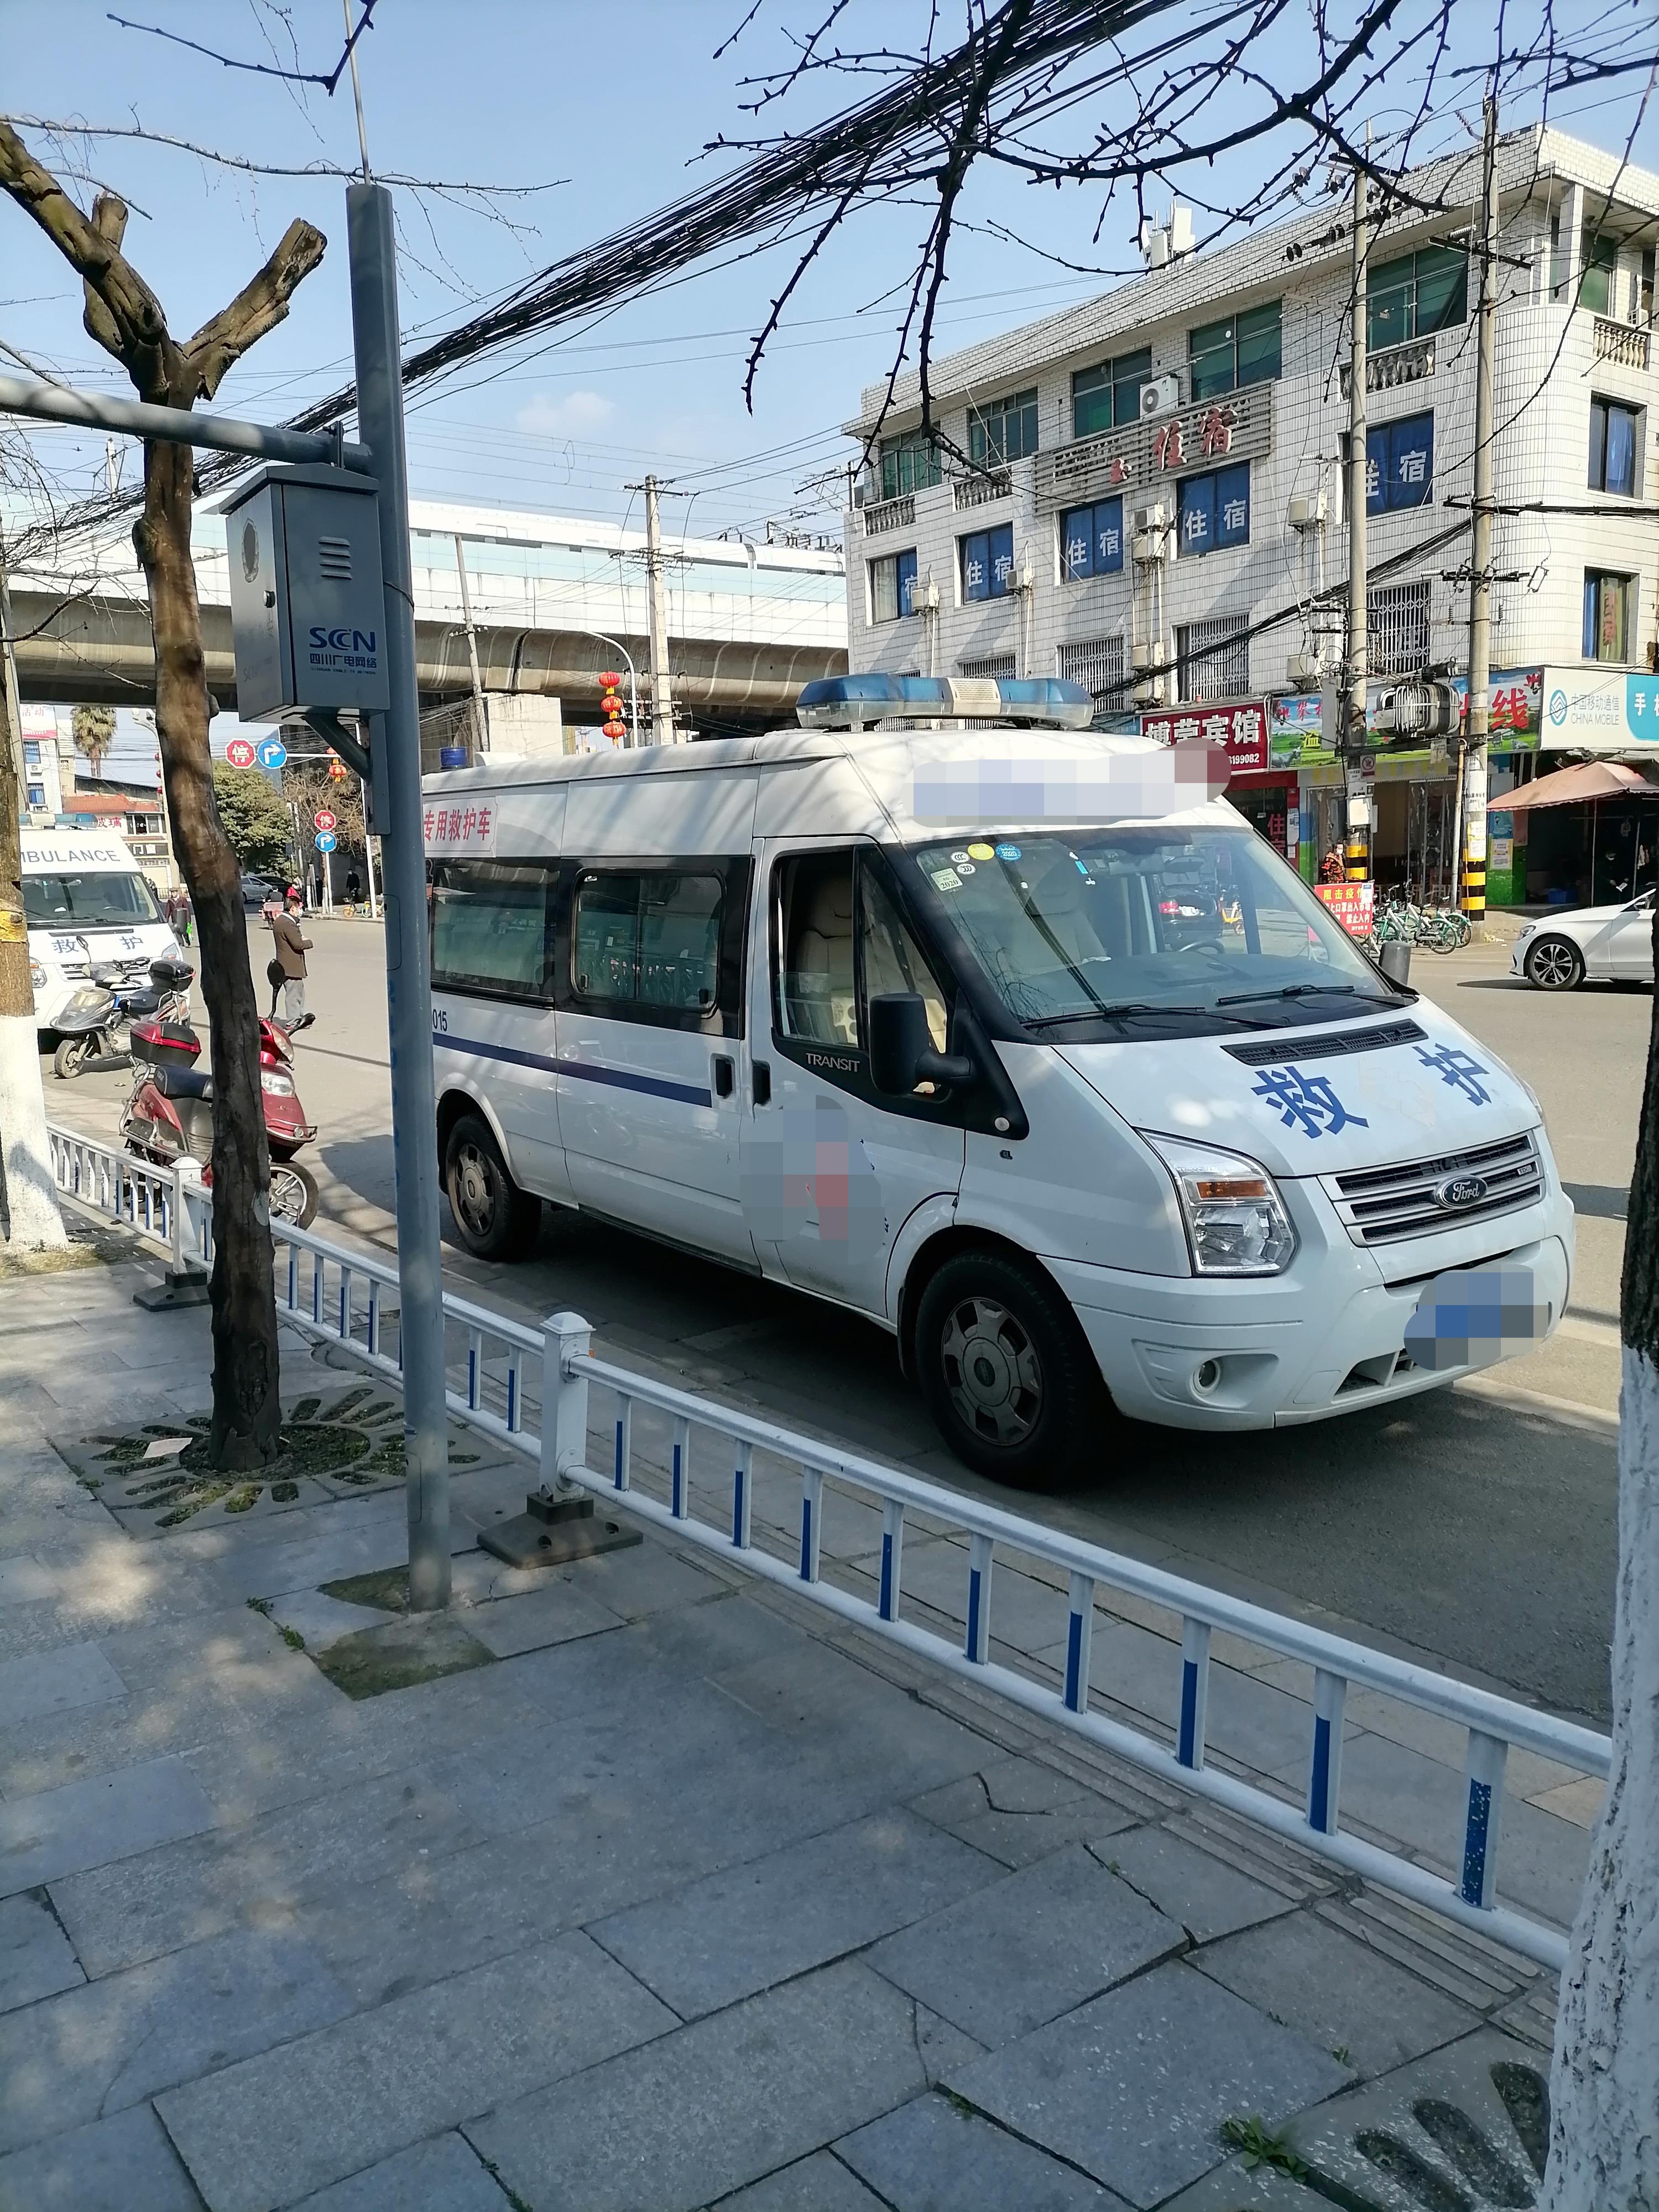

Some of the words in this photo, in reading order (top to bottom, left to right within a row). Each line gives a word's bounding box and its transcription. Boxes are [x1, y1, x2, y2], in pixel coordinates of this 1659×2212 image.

[1152, 407, 1238, 471] 住宿
[1186, 499, 1246, 540] 住宿
[1068, 529, 1119, 566] 住宿
[966, 555, 1011, 587] 住宿
[310, 653, 377, 668] 四川广电网络
[1571, 693, 1619, 711] 中国移动通信
[1571, 713, 1593, 724] CHINA
[1595, 713, 1619, 726] MOBILE
[232, 744, 249, 763] 停
[424, 807, 491, 841] 专用救护车
[941, 879, 959, 889] 2020
[432, 1009, 447, 1031] 015
[806, 1052, 860, 1072] TRANSIT
[1452, 1181, 1480, 1202] Ford
